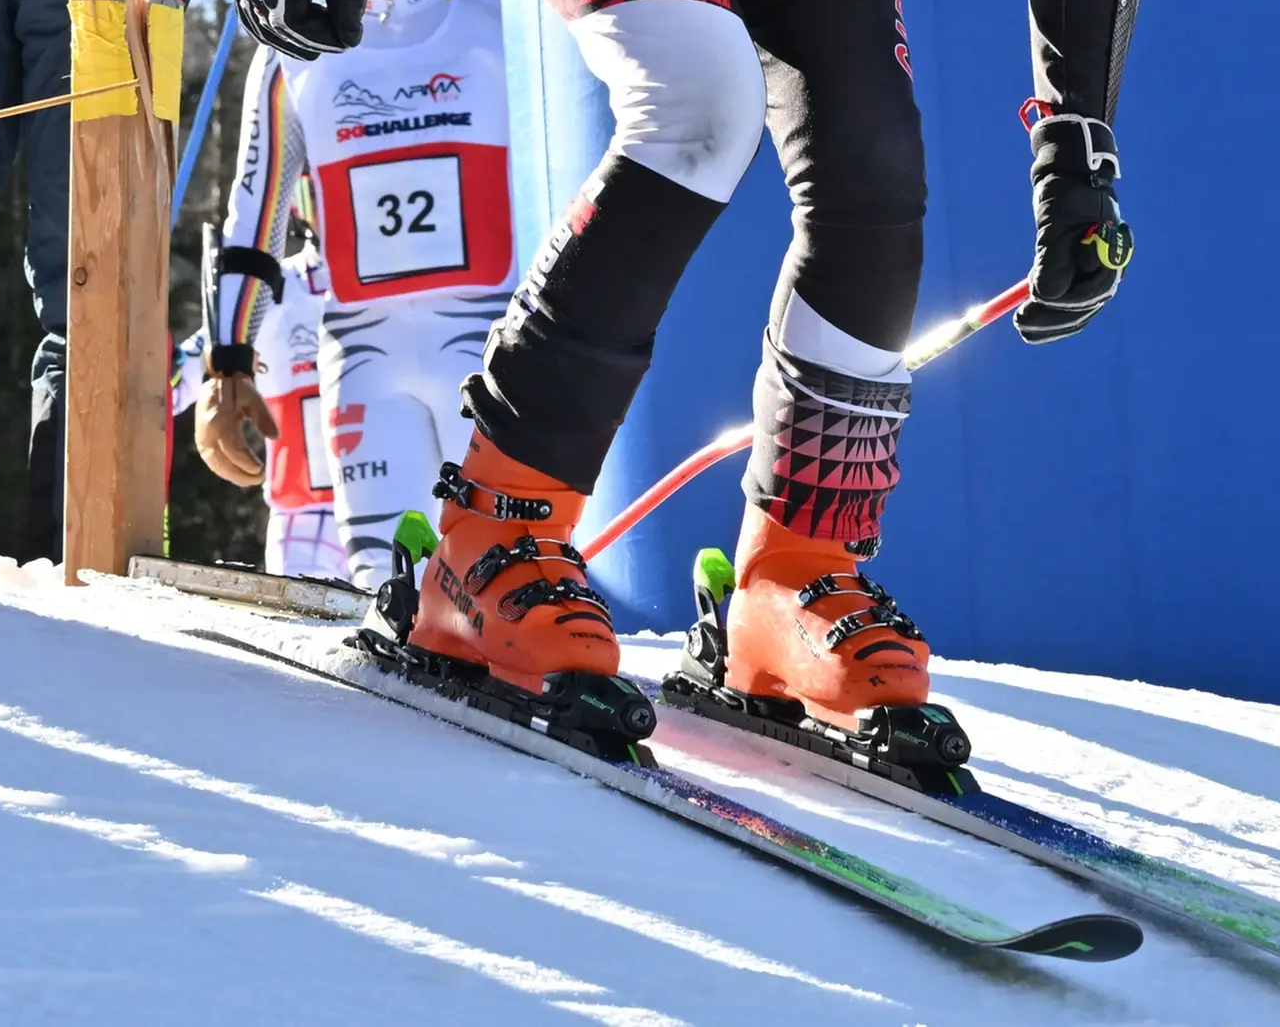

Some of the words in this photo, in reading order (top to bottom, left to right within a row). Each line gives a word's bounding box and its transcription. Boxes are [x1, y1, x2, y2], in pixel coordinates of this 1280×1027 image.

[377, 190, 436, 237] 32
[1115, 233, 1123, 263] LEKI
[338, 460, 388, 485] RTH
